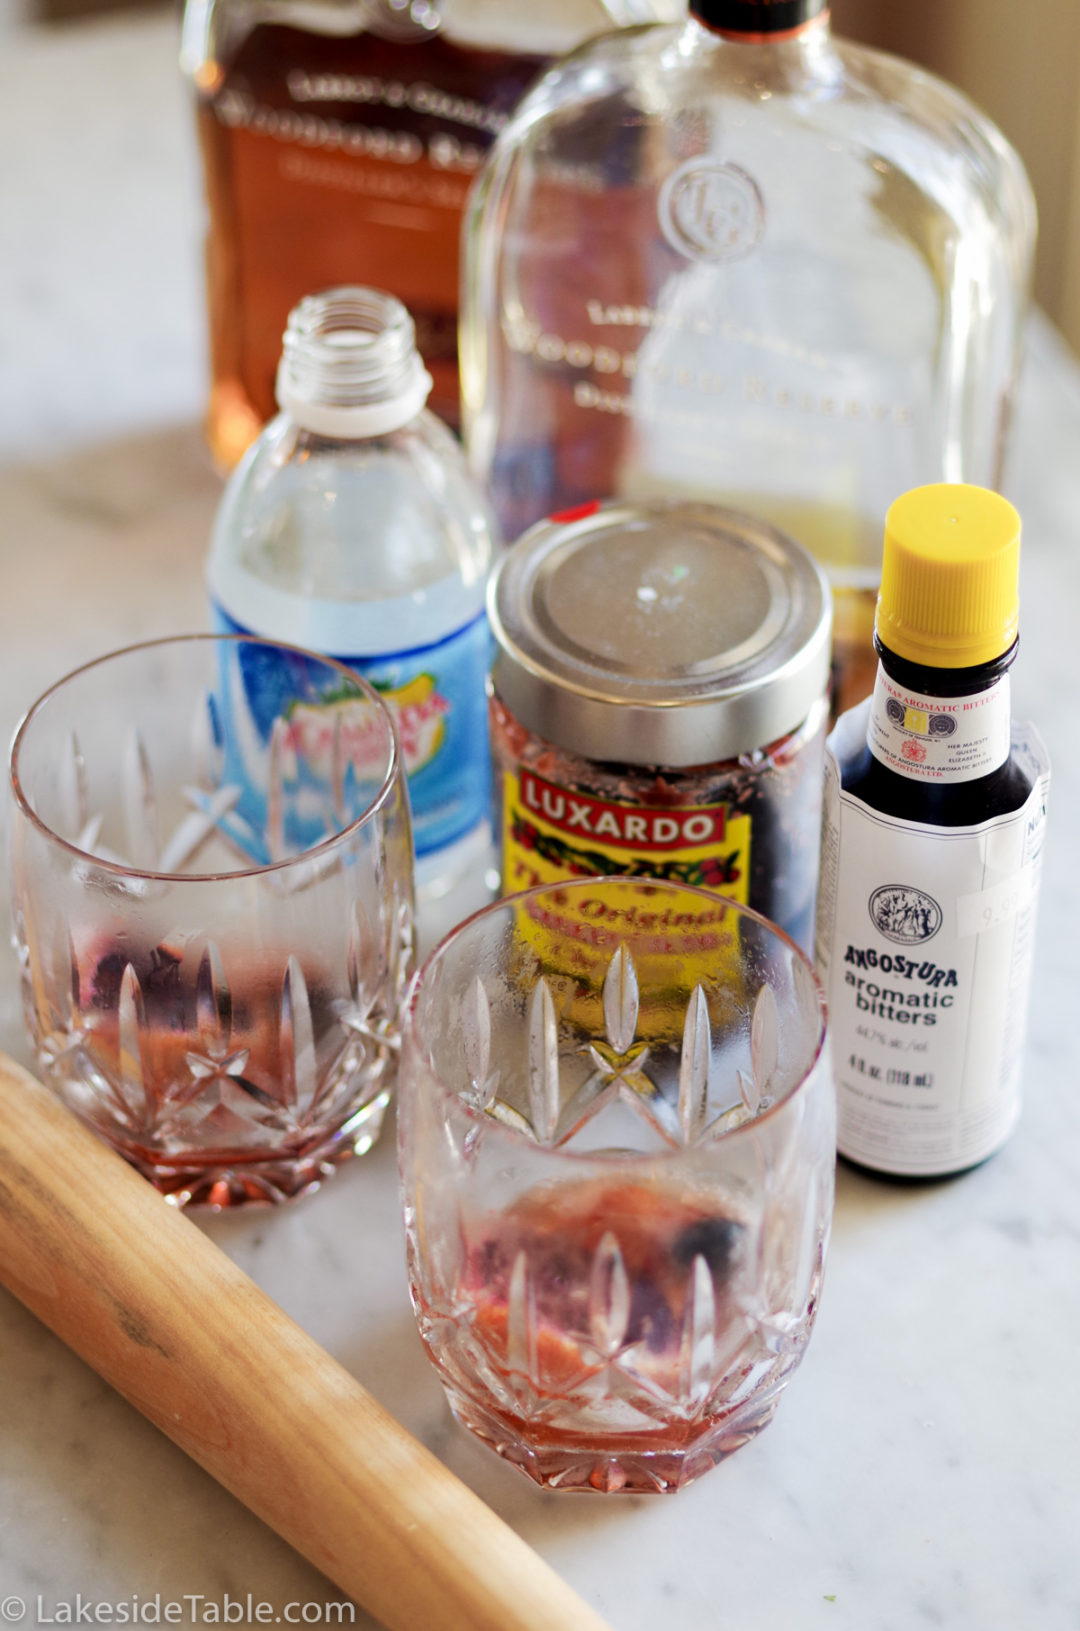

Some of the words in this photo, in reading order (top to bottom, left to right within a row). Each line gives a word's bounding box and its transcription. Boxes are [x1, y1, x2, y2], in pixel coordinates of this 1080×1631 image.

[903, 695, 960, 713] AROMATIC
[897, 757, 935, 772] ANGOSTURA
[526, 779, 715, 844] LUXARDO
[844, 945, 958, 988] ANGOSTURA
[845, 971, 954, 1008] aromatic
[856, 993, 938, 1026] bitters
